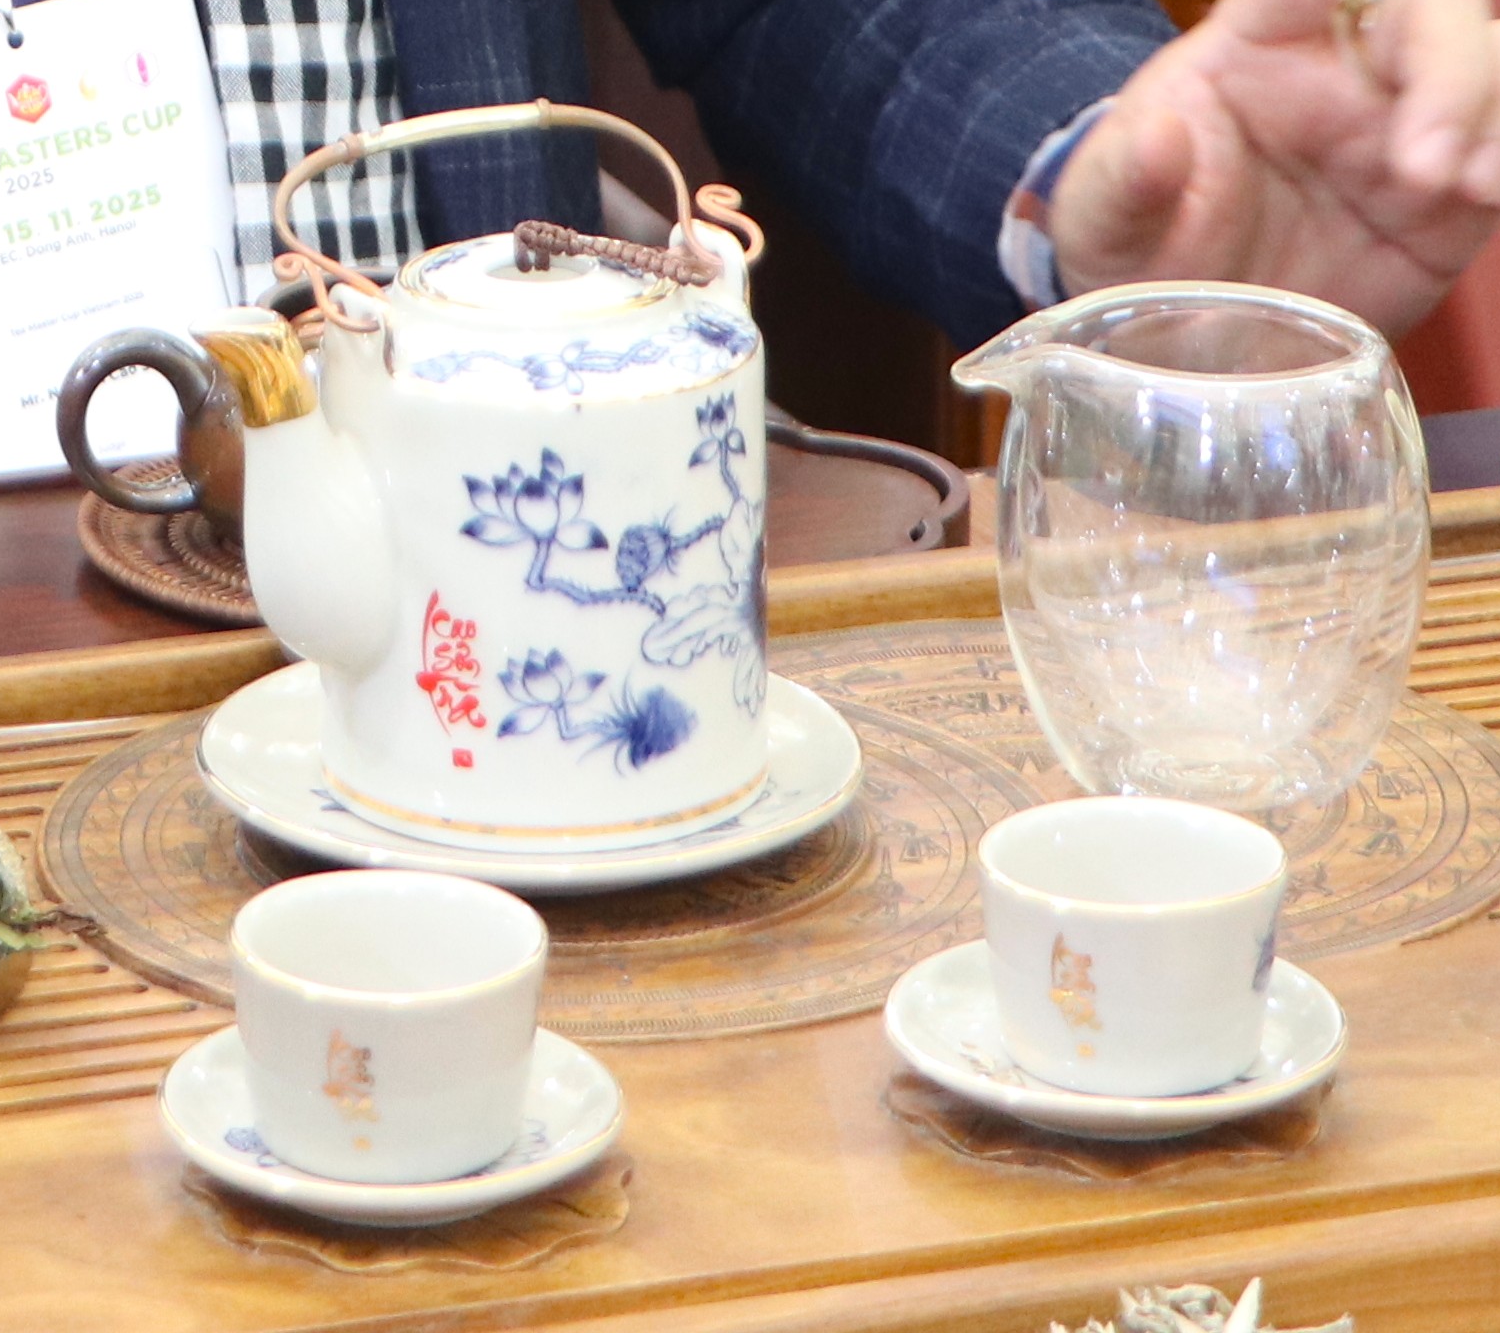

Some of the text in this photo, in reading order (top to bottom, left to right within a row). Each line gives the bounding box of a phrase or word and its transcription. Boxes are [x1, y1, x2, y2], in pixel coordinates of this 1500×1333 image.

[122, 101, 183, 137] CUP
[6, 167, 55, 195] 2025
[89, 183, 163, 223] 2025
[99, 218, 138, 238] Hanoi
[20, 394, 45, 409] Mr.
